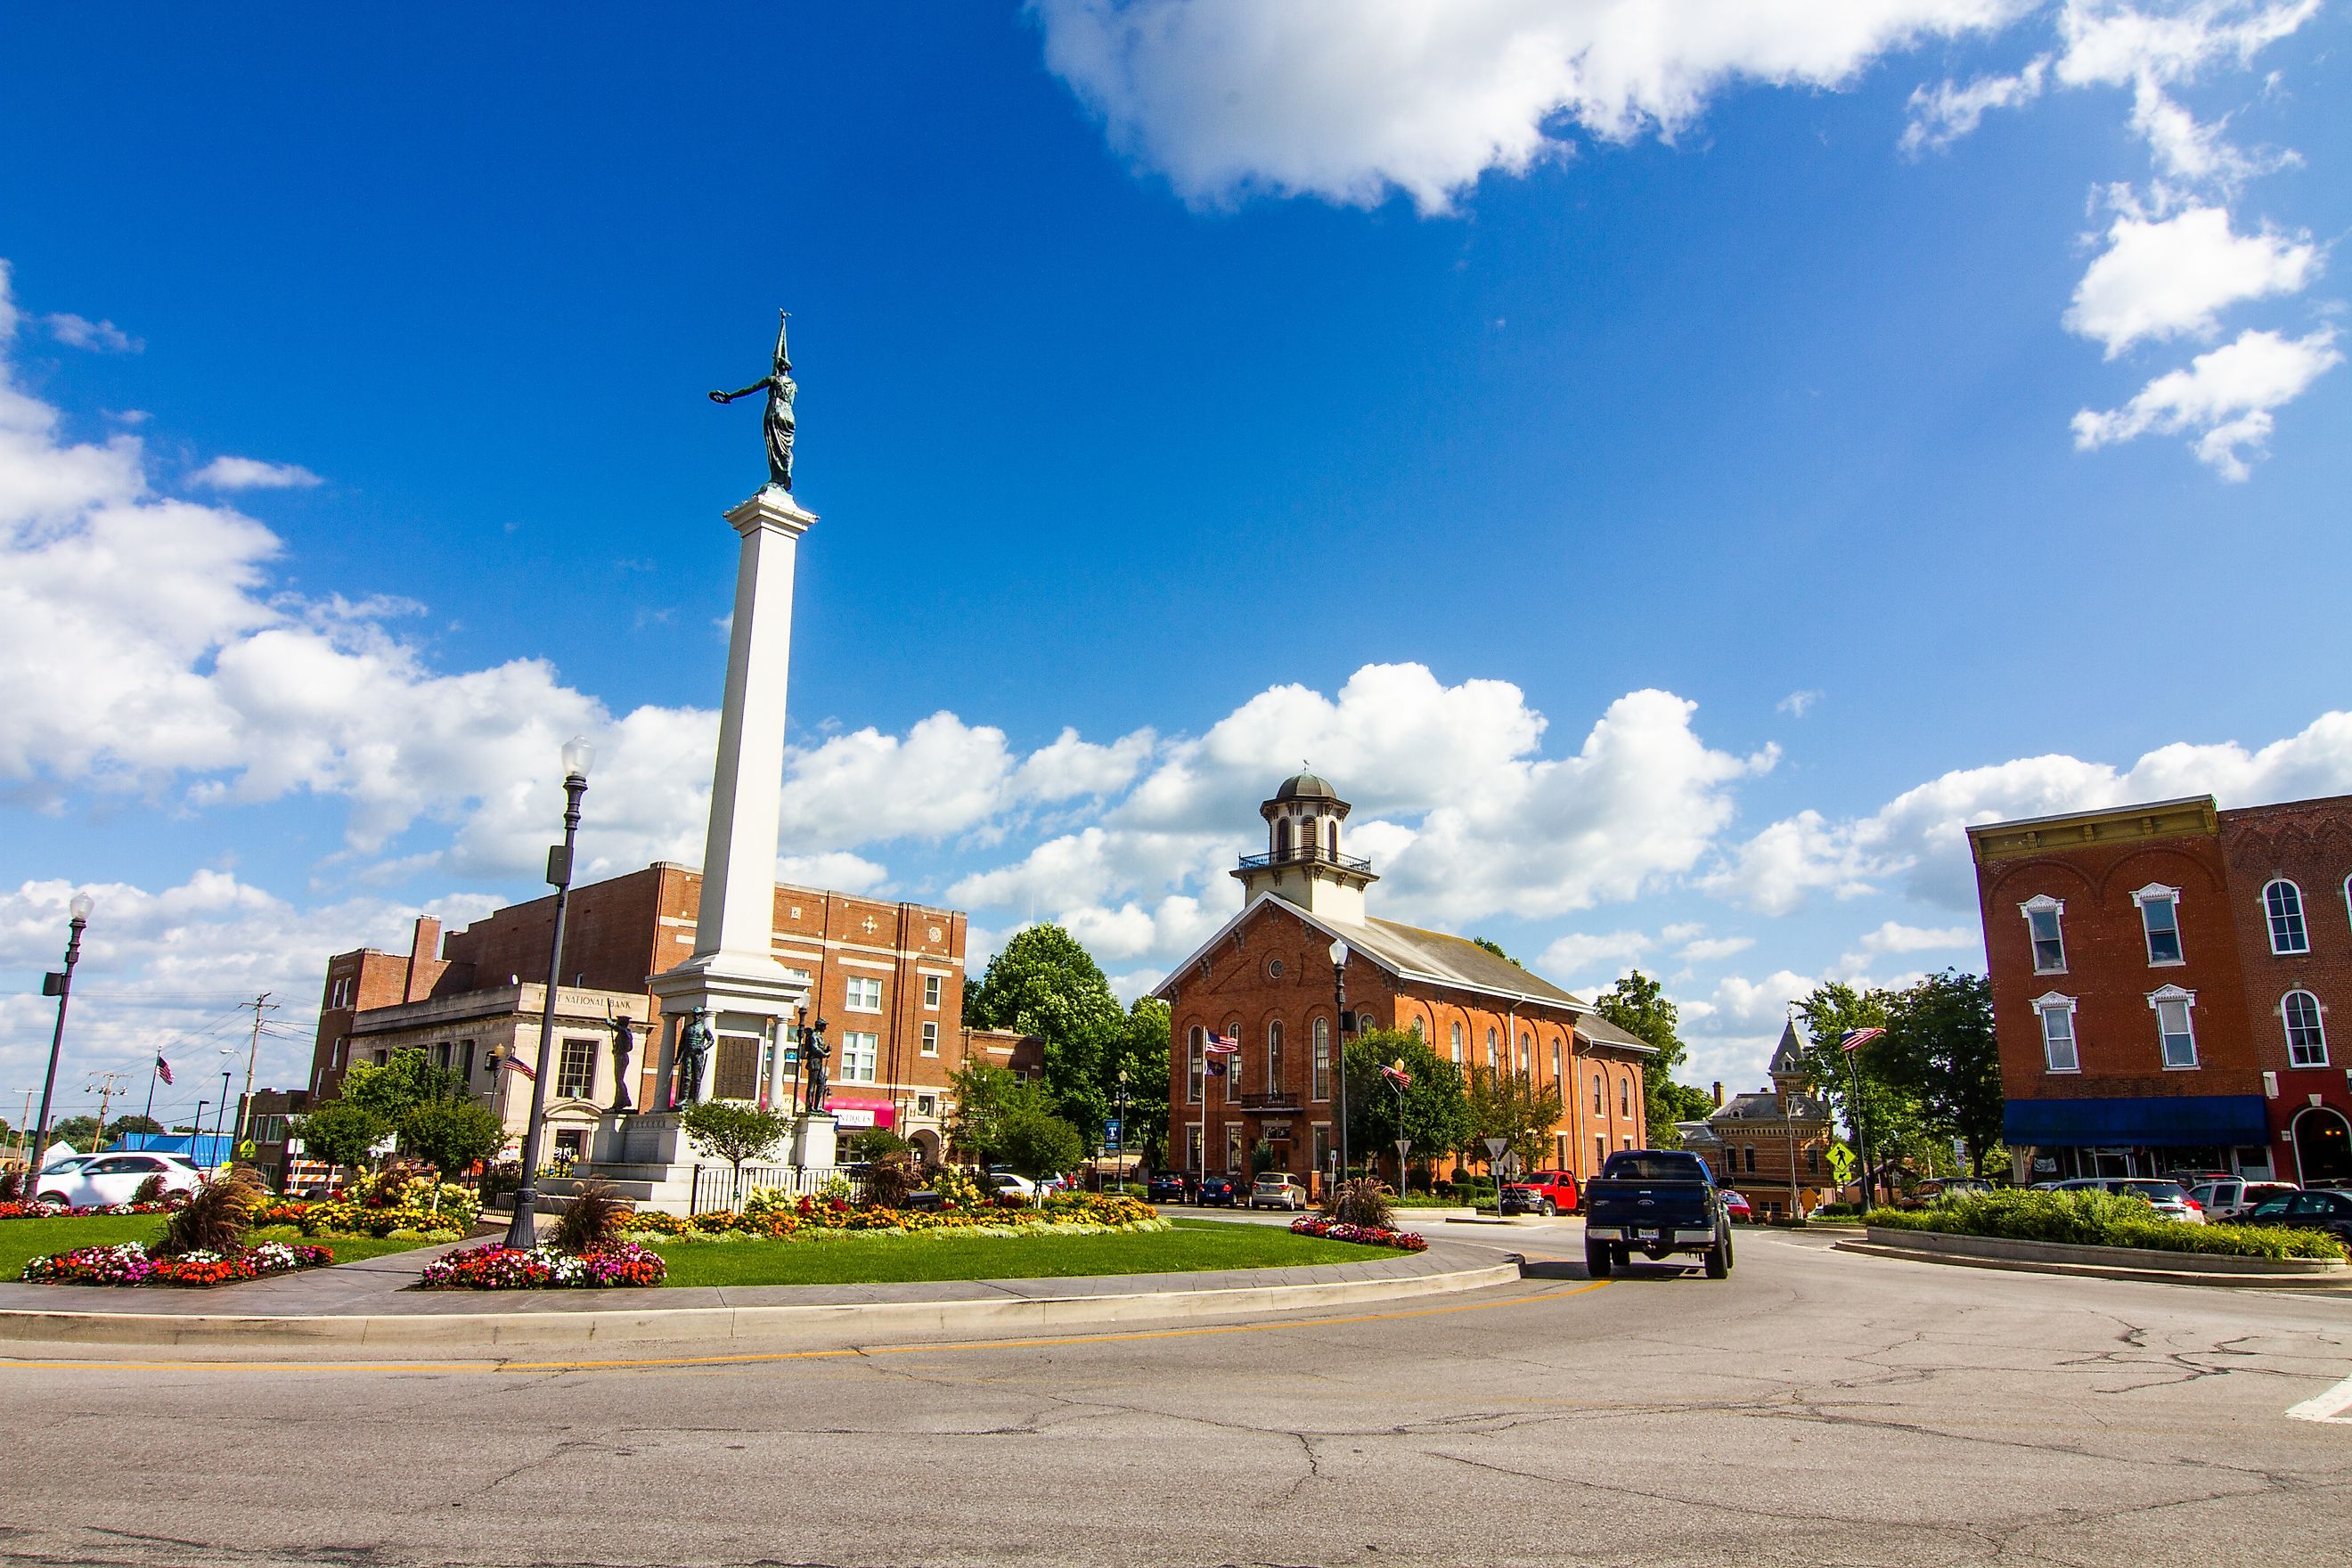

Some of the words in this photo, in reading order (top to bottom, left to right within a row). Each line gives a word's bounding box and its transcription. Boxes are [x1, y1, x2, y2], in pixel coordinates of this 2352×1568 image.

[566, 994, 605, 1007] NATIONAL
[609, 1000, 631, 1009] BANK
[839, 1114, 871, 1123] NTIQUES
